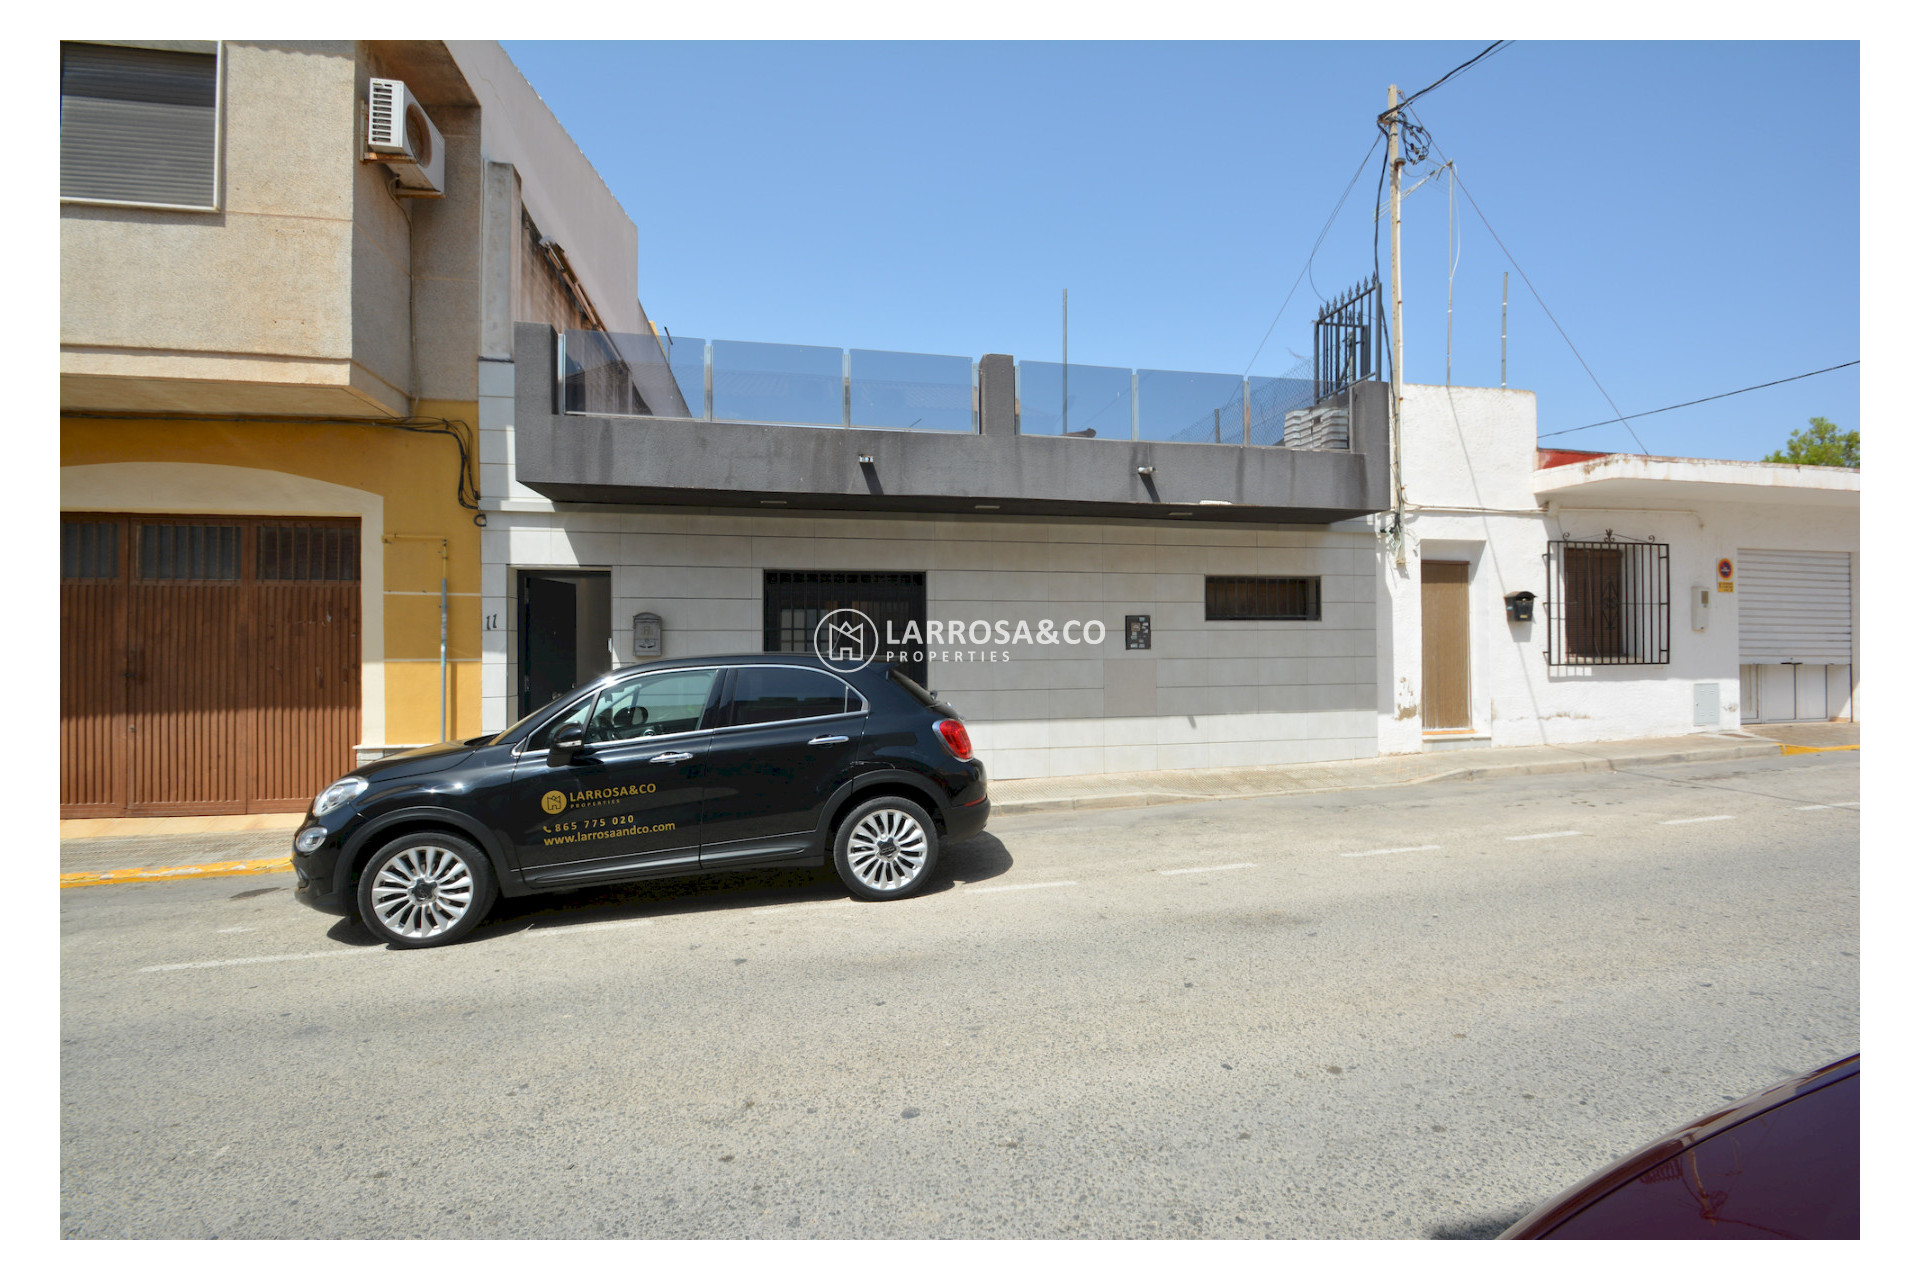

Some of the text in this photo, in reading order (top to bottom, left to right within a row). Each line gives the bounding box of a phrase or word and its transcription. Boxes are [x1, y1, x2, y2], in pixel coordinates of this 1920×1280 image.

[569, 783, 657, 803] LARROSA&CO
[570, 799, 621, 809] PROPERTIES
[554, 814, 634, 833] 865 775 020
[544, 822, 675, 846] www.larrosaandco.com
